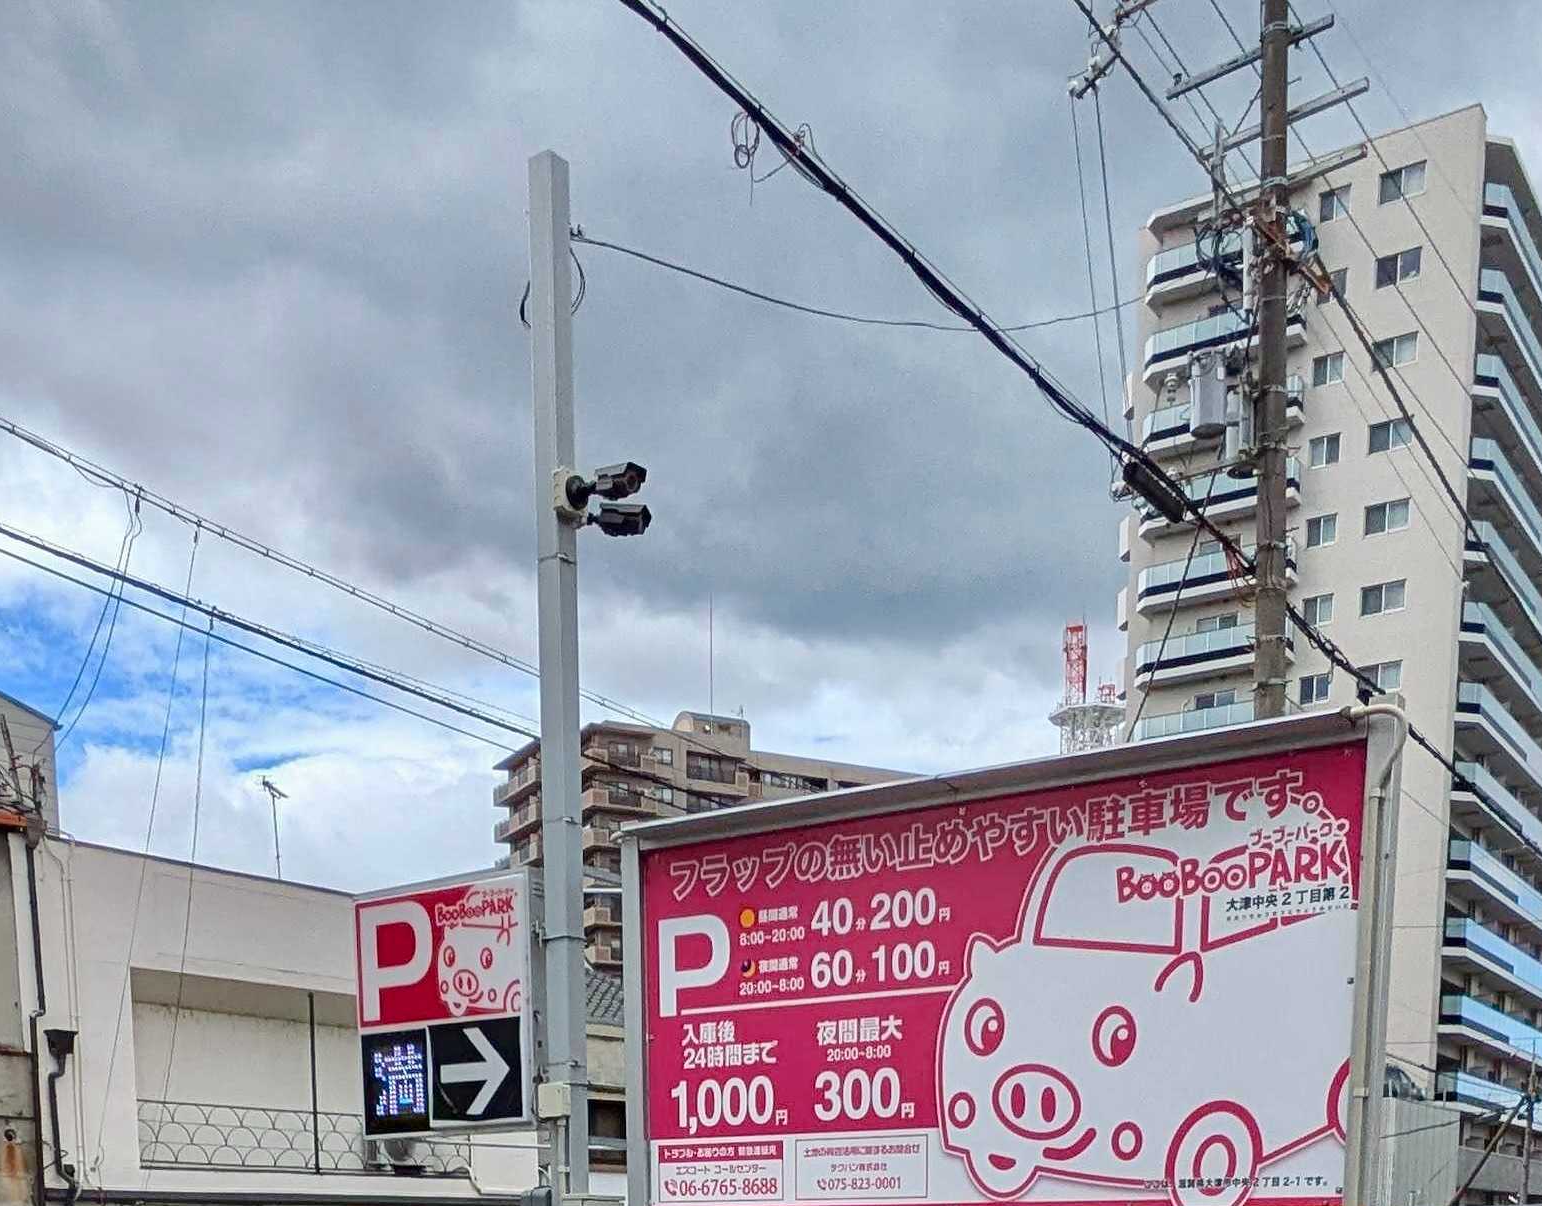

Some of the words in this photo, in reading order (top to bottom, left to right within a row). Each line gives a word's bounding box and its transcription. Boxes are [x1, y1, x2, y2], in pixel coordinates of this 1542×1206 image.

[670, 769, 1325, 902] フラップの無い止めやすい駐車場です。
[361, 900, 433, 1022] P
[657, 914, 731, 1018] P
[681, 1020, 735, 1047] 入庫後
[816, 1015, 903, 1047] 夜間最大
[682, 1040, 779, 1070] 24時間まで
[679, 1177, 778, 1197] 06-6765-8688
[827, 1176, 902, 1191] 075-823-0001
